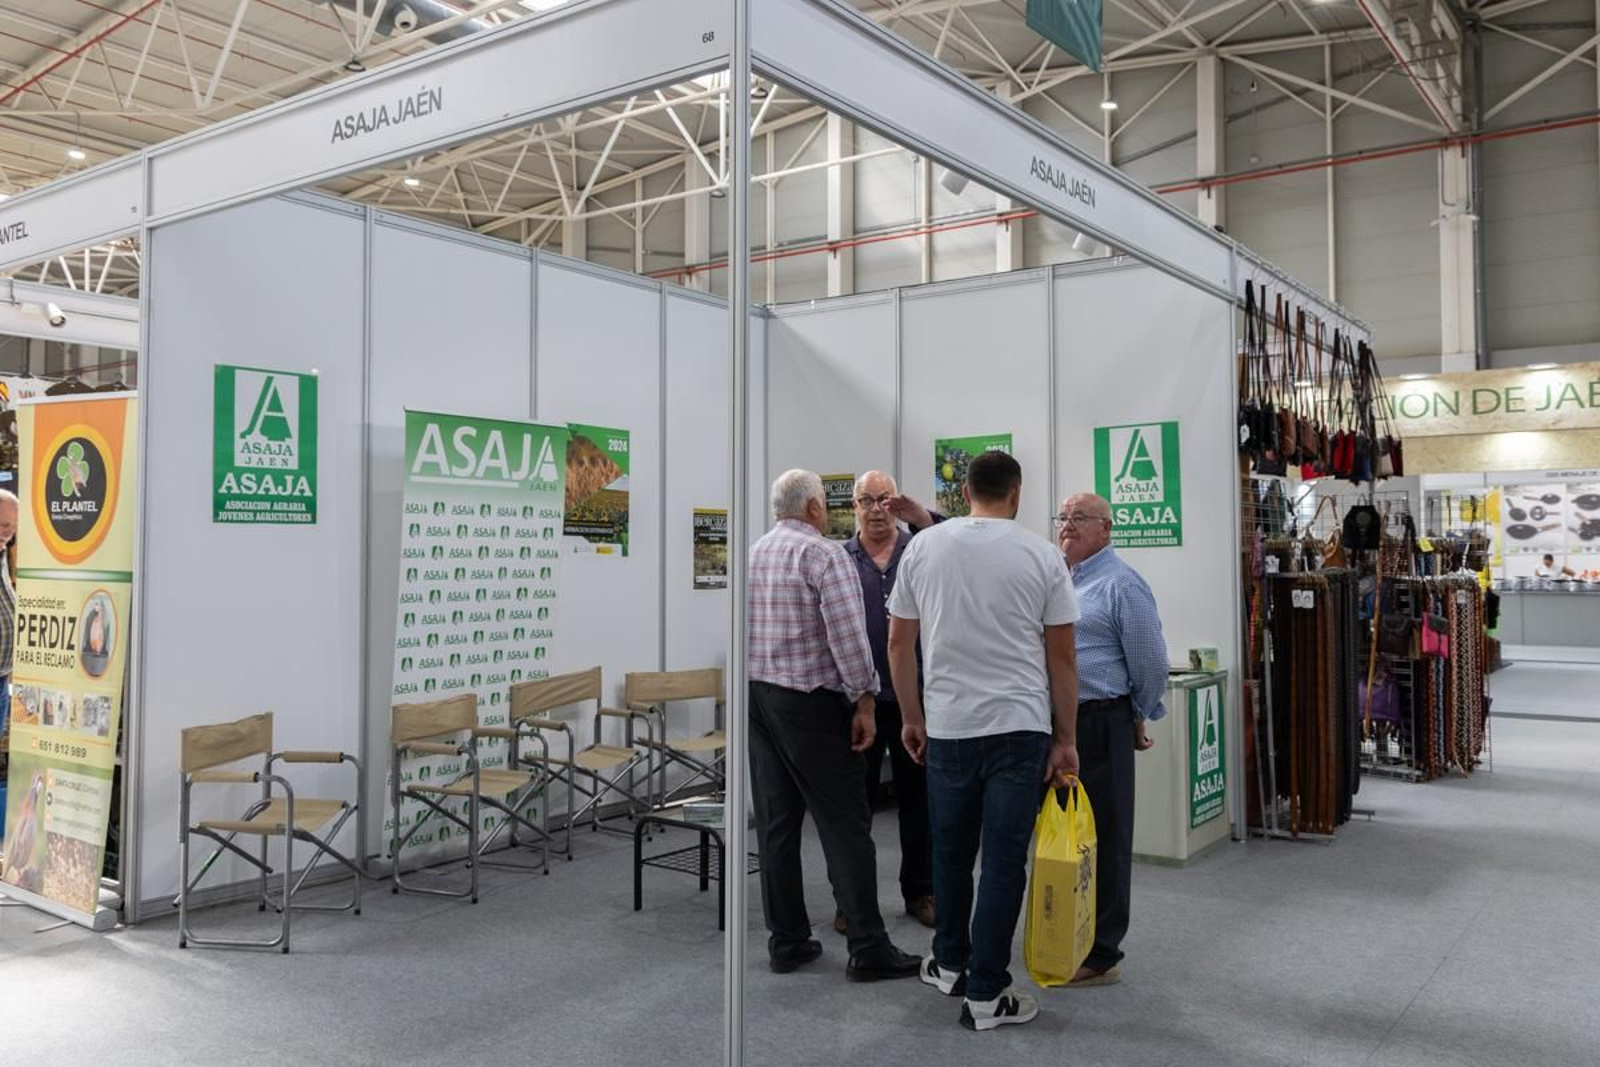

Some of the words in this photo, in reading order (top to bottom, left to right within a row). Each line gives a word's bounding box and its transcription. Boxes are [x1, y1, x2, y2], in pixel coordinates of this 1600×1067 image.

[702, 31, 715, 43] 68
[331, 105, 390, 145] ASAJA
[392, 85, 442, 125] JAÉN
[1030, 155, 1067, 193] ASAJA
[1068, 178, 1096, 209] JAÉN
[1472, 386, 1526, 416] DE
[240, 442, 293, 456] ASAJA
[411, 423, 559, 483] ASAJA
[608, 439, 628, 452] 2024
[245, 457, 289, 467] JAEN
[218, 472, 313, 496] ASAJA
[1116, 482, 1159, 494] ASAJA
[1119, 494, 1155, 502] JAEN
[51, 501, 61, 512] EL
[62, 501, 98, 512] PLANTEL
[405, 503, 428, 513] ASAJA
[451, 505, 475, 515] ASAJA
[497, 507, 517, 517] ASAJA
[539, 509, 561, 519] ASAJA
[426, 526, 450, 537] ASAJA
[473, 527, 496, 537] ASAJA
[514, 528, 538, 538] ASAJA
[403, 547, 425, 558] ASAJA
[449, 547, 472, 558] ASAJA
[494, 548, 514, 558] ASAJA
[536, 549, 559, 559] ASAJA
[424, 570, 448, 580] ASAJA
[470, 569, 493, 579] ASAJA
[511, 569, 535, 579] ASAJA
[400, 593, 423, 604] ASAJA
[447, 592, 470, 602] ASAJA
[492, 590, 511, 600] ASAJA
[533, 588, 556, 599] ASAJA
[421, 613, 446, 624] ASAJA
[468, 611, 491, 621] ASAJA
[509, 609, 532, 619] ASAJA
[16, 613, 77, 651] PERDIZ
[397, 637, 421, 648] ASAJA
[444, 634, 468, 645] ASAJA
[488, 631, 509, 641] ASAJA
[530, 628, 553, 639] ASAJA
[16, 650, 35, 664] PARA
[36, 651, 43, 666] EL
[44, 652, 75, 669] RECLAMO
[419, 657, 444, 669] ASAJA
[466, 653, 488, 664] ASAJA
[506, 650, 529, 660] ASAJA
[394, 682, 418, 694] ASAJA
[441, 678, 465, 689] ASAJA
[486, 674, 506, 684] ASAJA
[527, 669, 549, 680] ASAJA
[484, 715, 504, 726] ASAJA
[436, 763, 460, 776] ASAJA
[481, 756, 503, 768] ASAJA
[1193, 772, 1225, 802] ASAJA
